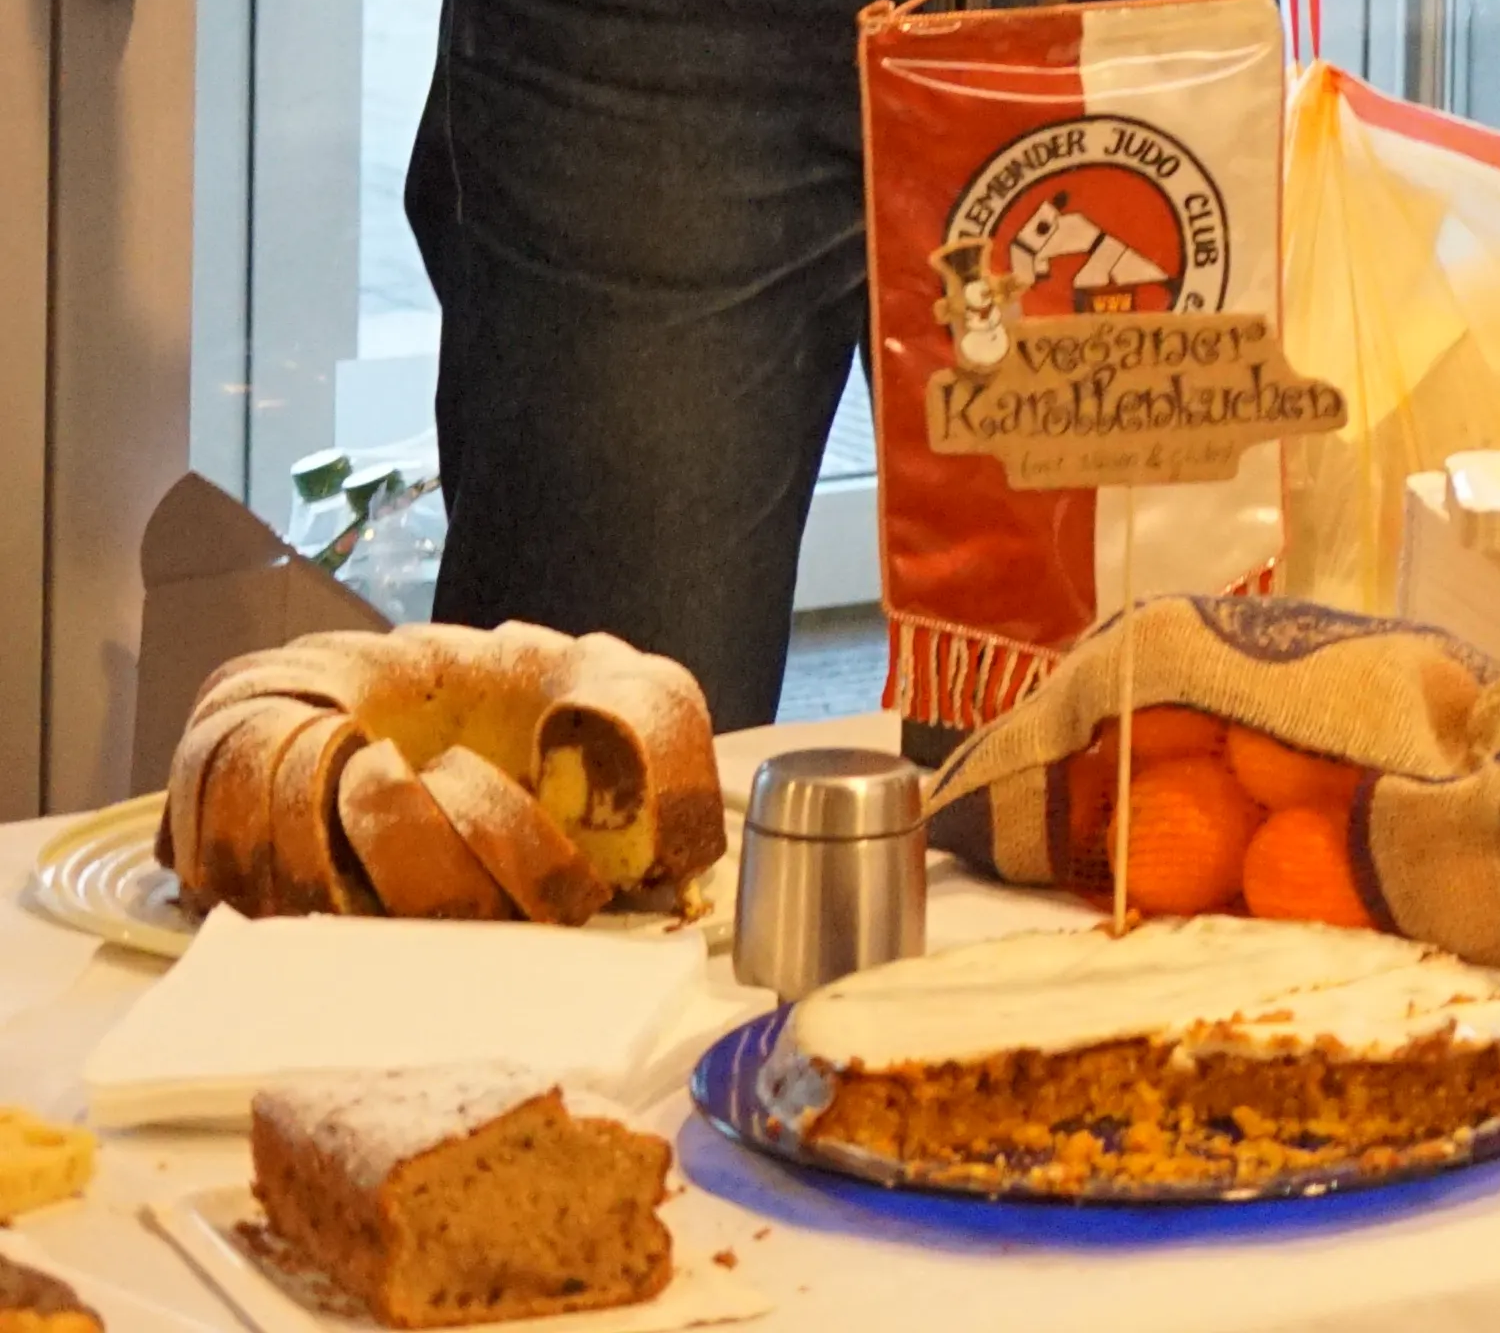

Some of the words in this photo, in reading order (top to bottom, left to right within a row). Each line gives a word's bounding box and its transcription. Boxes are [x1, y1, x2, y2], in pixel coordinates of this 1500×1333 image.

[1104, 127, 1181, 179] JUDO
[1183, 192, 1219, 269] CLUB
[1017, 322, 1266, 373] veganer
[941, 364, 1344, 440] Karottenkuchen
